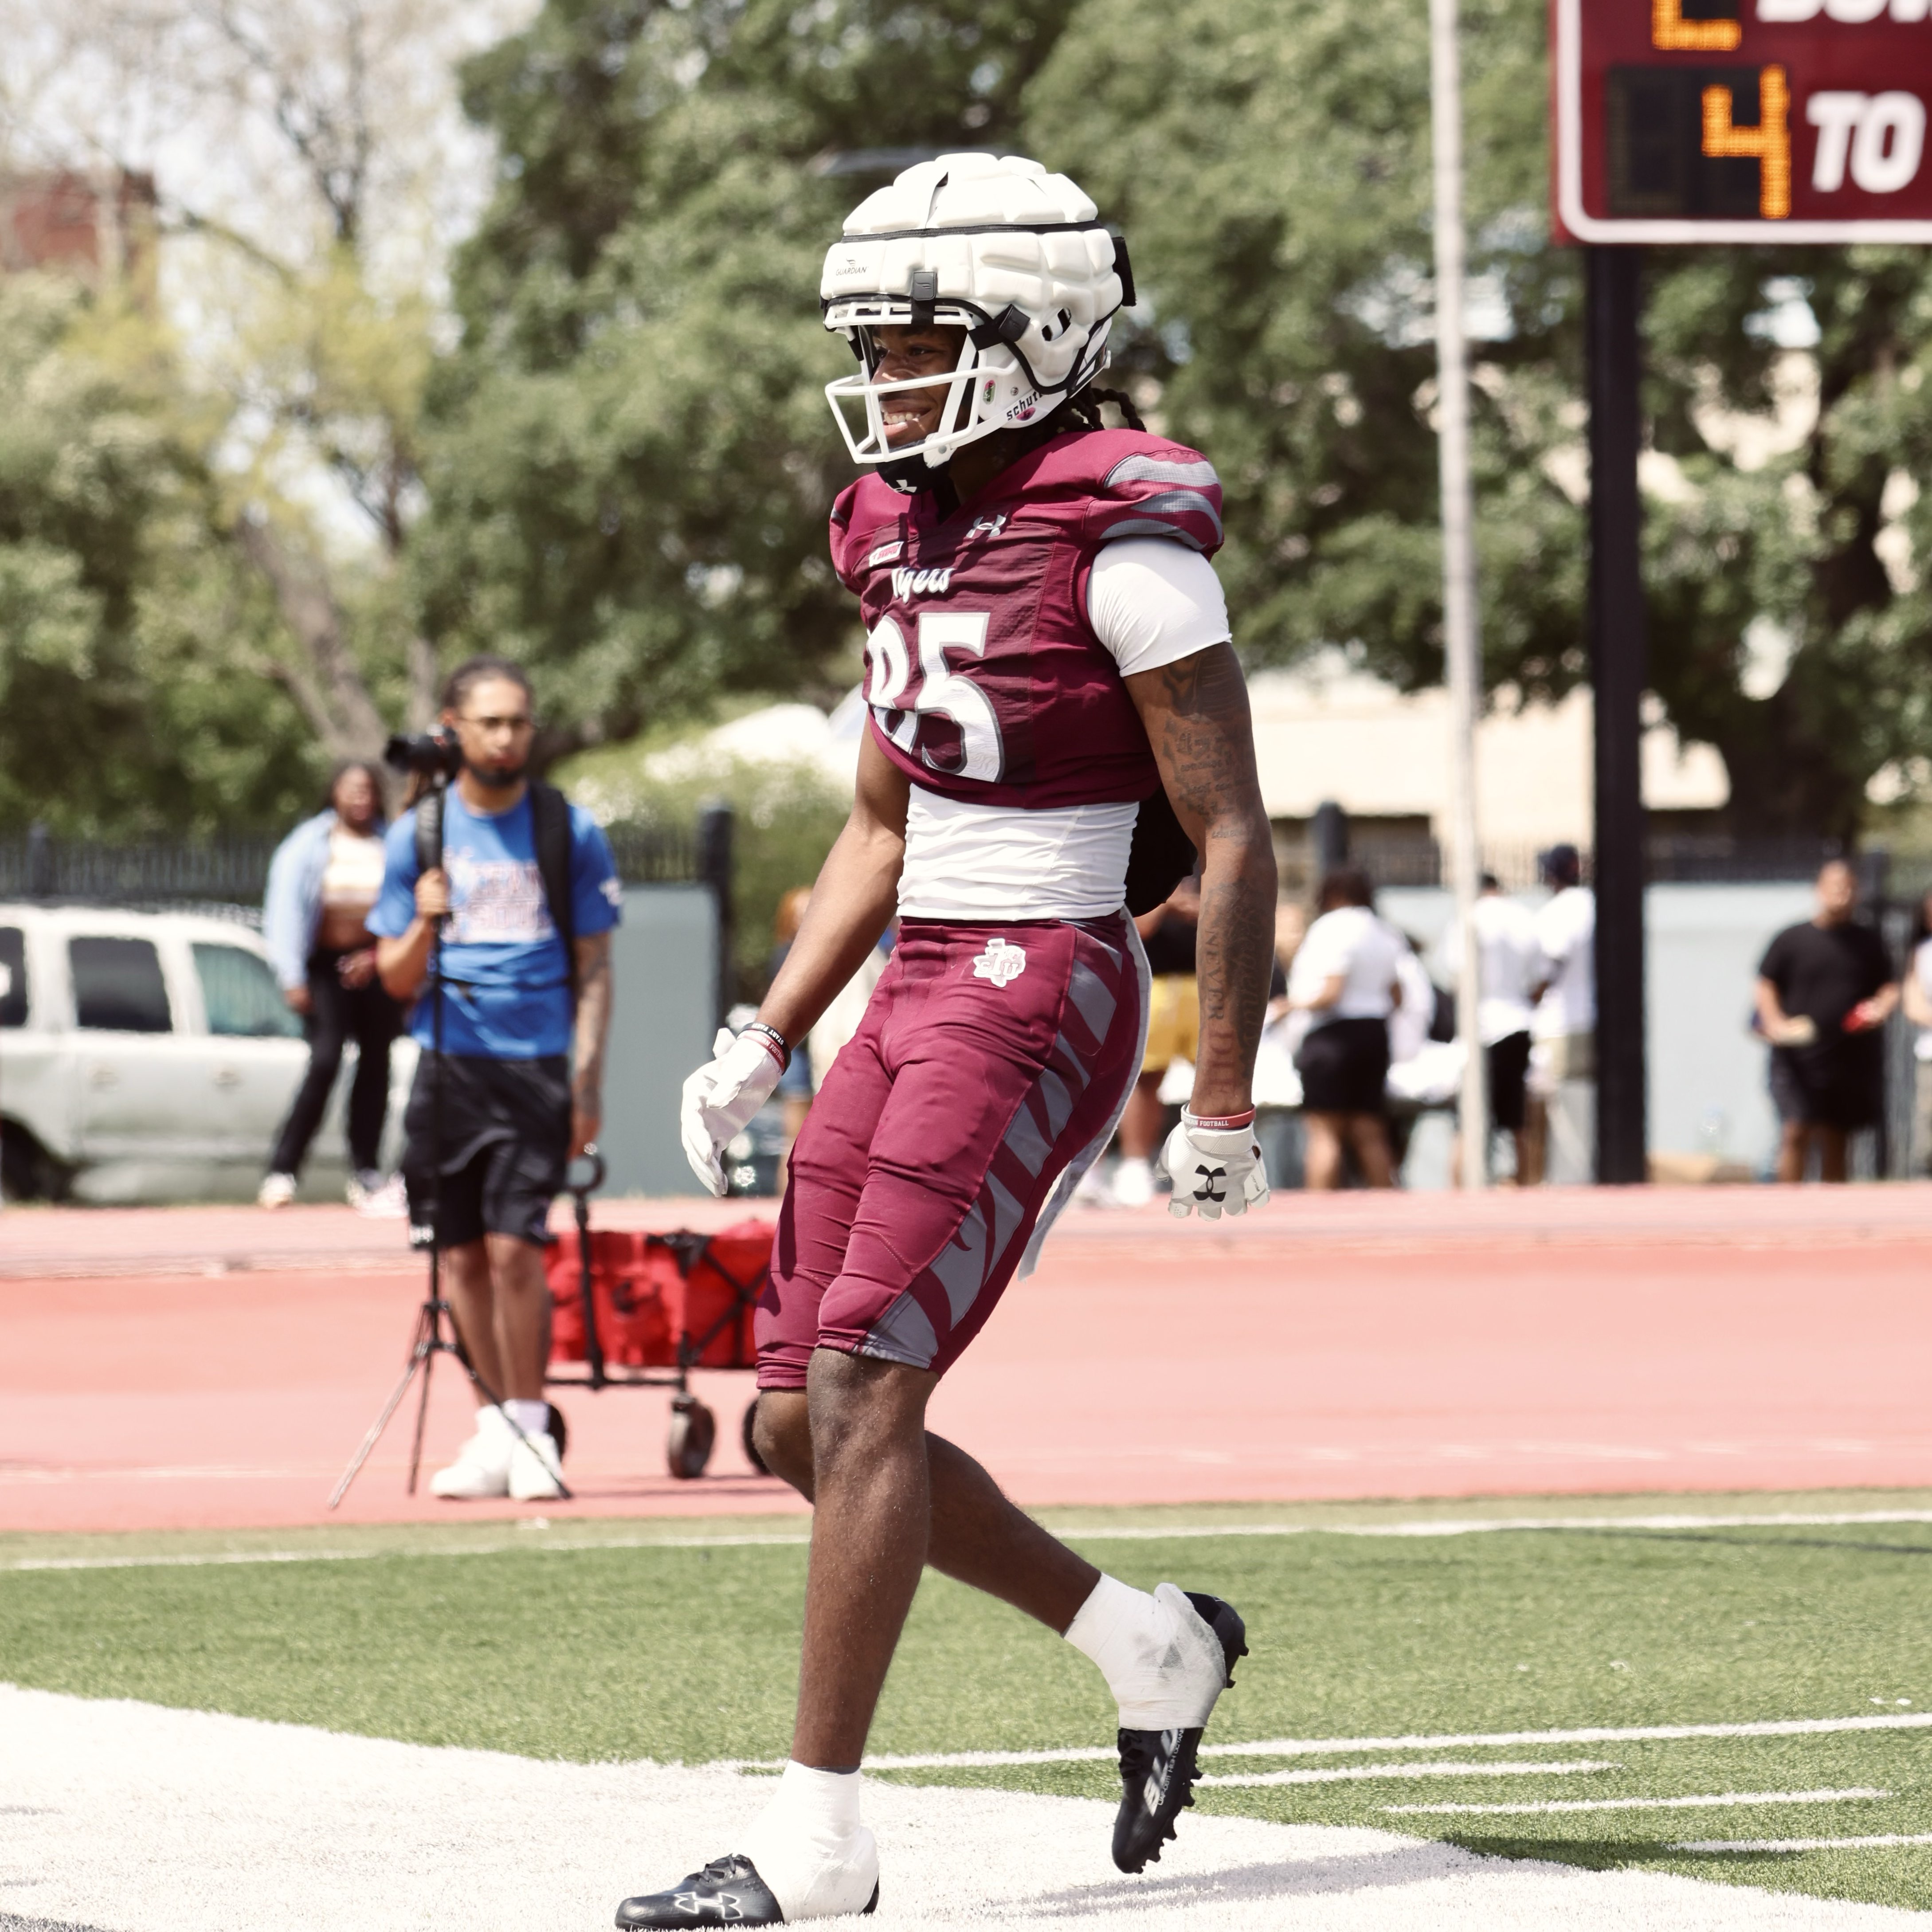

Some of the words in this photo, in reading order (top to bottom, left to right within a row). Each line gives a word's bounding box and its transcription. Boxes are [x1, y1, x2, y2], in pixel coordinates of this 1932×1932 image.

[1701, 63, 1791, 219] 4
[1806, 90, 1926, 193] TO
[836, 266, 867, 276] GUARDIAN
[1006, 391, 1044, 421] schut
[1205, 930, 1224, 1020] NEVER
[768, 1029, 784, 1046] START
[769, 1044, 785, 1063] FOOTBALL
